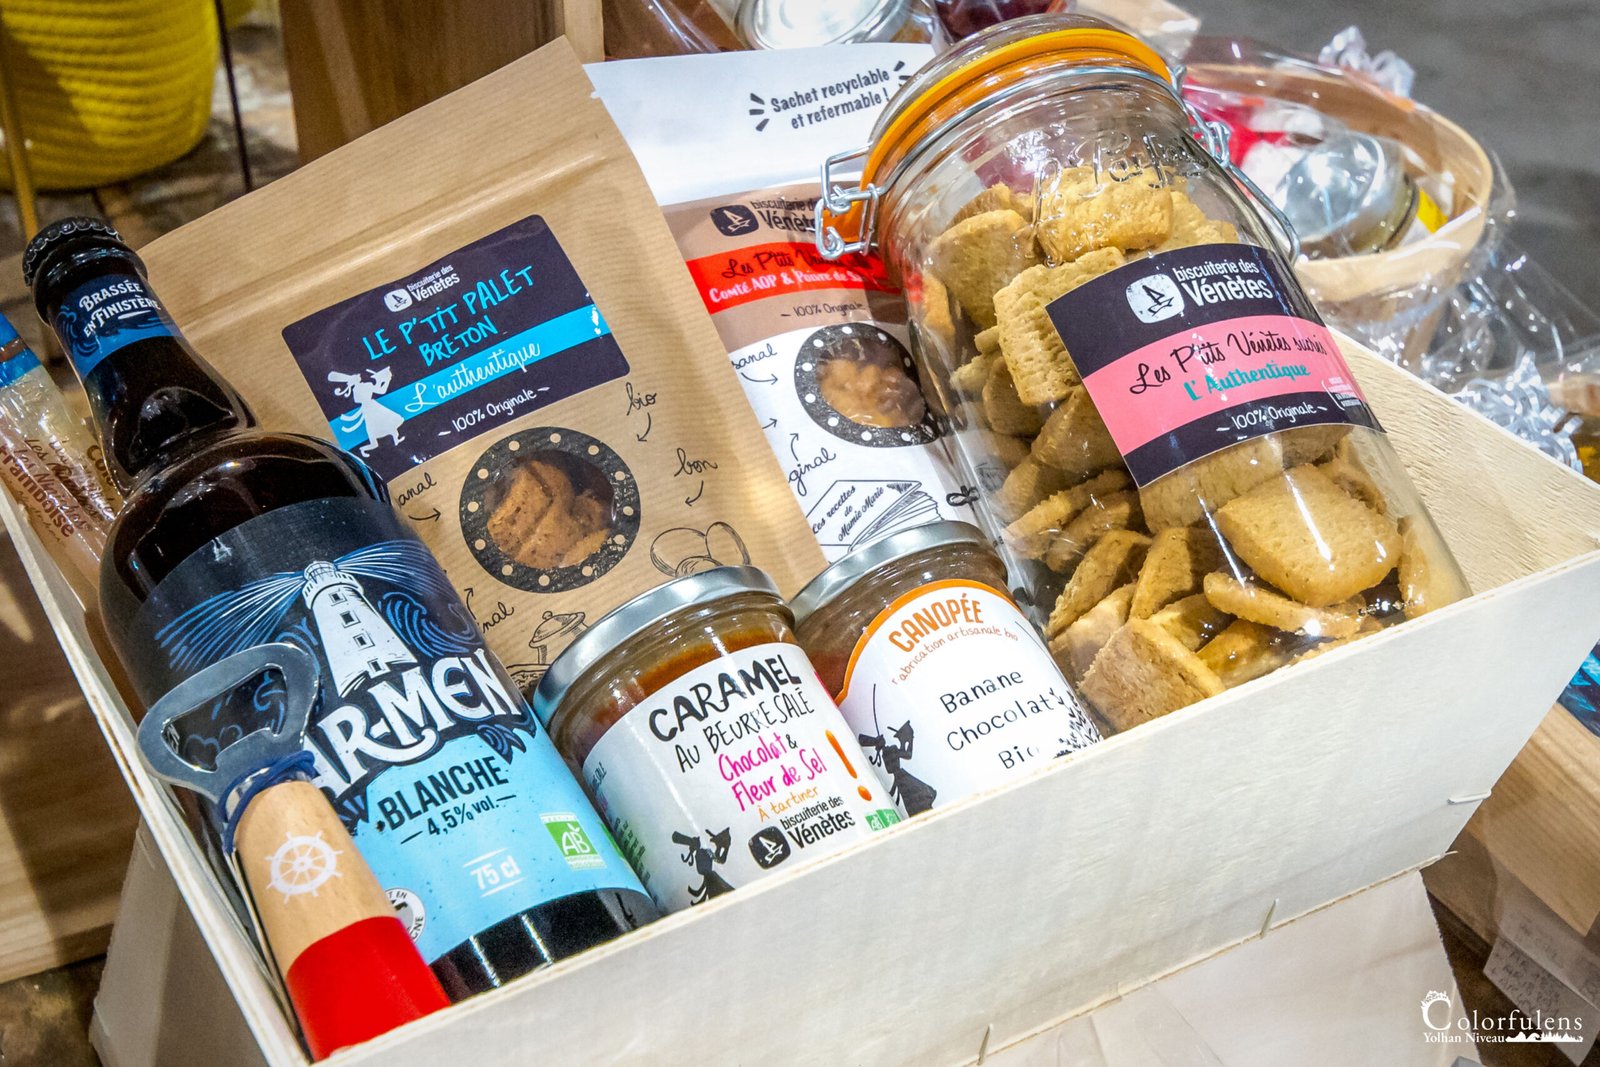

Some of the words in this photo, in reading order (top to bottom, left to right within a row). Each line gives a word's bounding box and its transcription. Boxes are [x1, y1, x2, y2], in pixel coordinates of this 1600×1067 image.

[770, 87, 819, 113] Sachet
[821, 68, 890, 99] recyclable
[791, 113, 804, 129] et
[807, 93, 882, 125] refermable
[758, 209, 816, 233] Vénèt
[407, 268, 441, 293] biscuiterie
[440, 264, 454, 277] des
[722, 258, 754, 279] Les
[1173, 260, 1239, 282] biscuiterie
[1238, 259, 1260, 274] des
[79, 280, 144, 312] BRASSÉE
[411, 270, 461, 302] Vénètes
[709, 281, 751, 303] Comté
[752, 275, 777, 292] AOP
[781, 272, 794, 286] &
[1181, 275, 1274, 307] Vénètes
[362, 328, 397, 360] LE
[462, 265, 533, 316] PALET
[793, 304, 822, 317] 100%
[83, 320, 97, 338] EN
[418, 315, 498, 367] BRETON
[731, 343, 778, 370] sanal
[1129, 363, 1171, 394] Les
[1227, 331, 1290, 357] Vénètes
[405, 342, 541, 412] L'authentique
[452, 408, 486, 433] 100%
[486, 387, 537, 420] Originale
[626, 382, 658, 416] bio
[1231, 408, 1267, 430] 100%
[1267, 401, 1317, 425] Originale
[674, 448, 719, 478] bon
[788, 447, 837, 497] ginal
[398, 472, 437, 507] anal
[826, 485, 856, 518] recettes
[838, 510, 863, 542] Mamie
[861, 486, 884, 513] Marie
[844, 505, 853, 517] de
[888, 593, 984, 652] CANOPÉE
[947, 625, 1002, 642] artisanale
[1004, 627, 1019, 641] bio
[649, 655, 802, 742] CARAMEL
[773, 687, 815, 724] SALÉ
[940, 670, 1024, 713] Banane
[946, 693, 1054, 751] Chocolat
[718, 732, 787, 781] Chocolat
[785, 733, 798, 749] &
[379, 755, 509, 831] BLANCHE
[731, 780, 777, 812] Fleur
[780, 764, 801, 786] de
[799, 748, 827, 781] Sel
[427, 802, 473, 836] 4,5%
[472, 799, 499, 820] vol.
[771, 786, 819, 815] tartiner
[780, 800, 828, 829] biscuiterie
[828, 796, 844, 809] des
[786, 809, 856, 849] Vénètes
[471, 863, 500, 886] 75
[499, 859, 521, 880] cl
